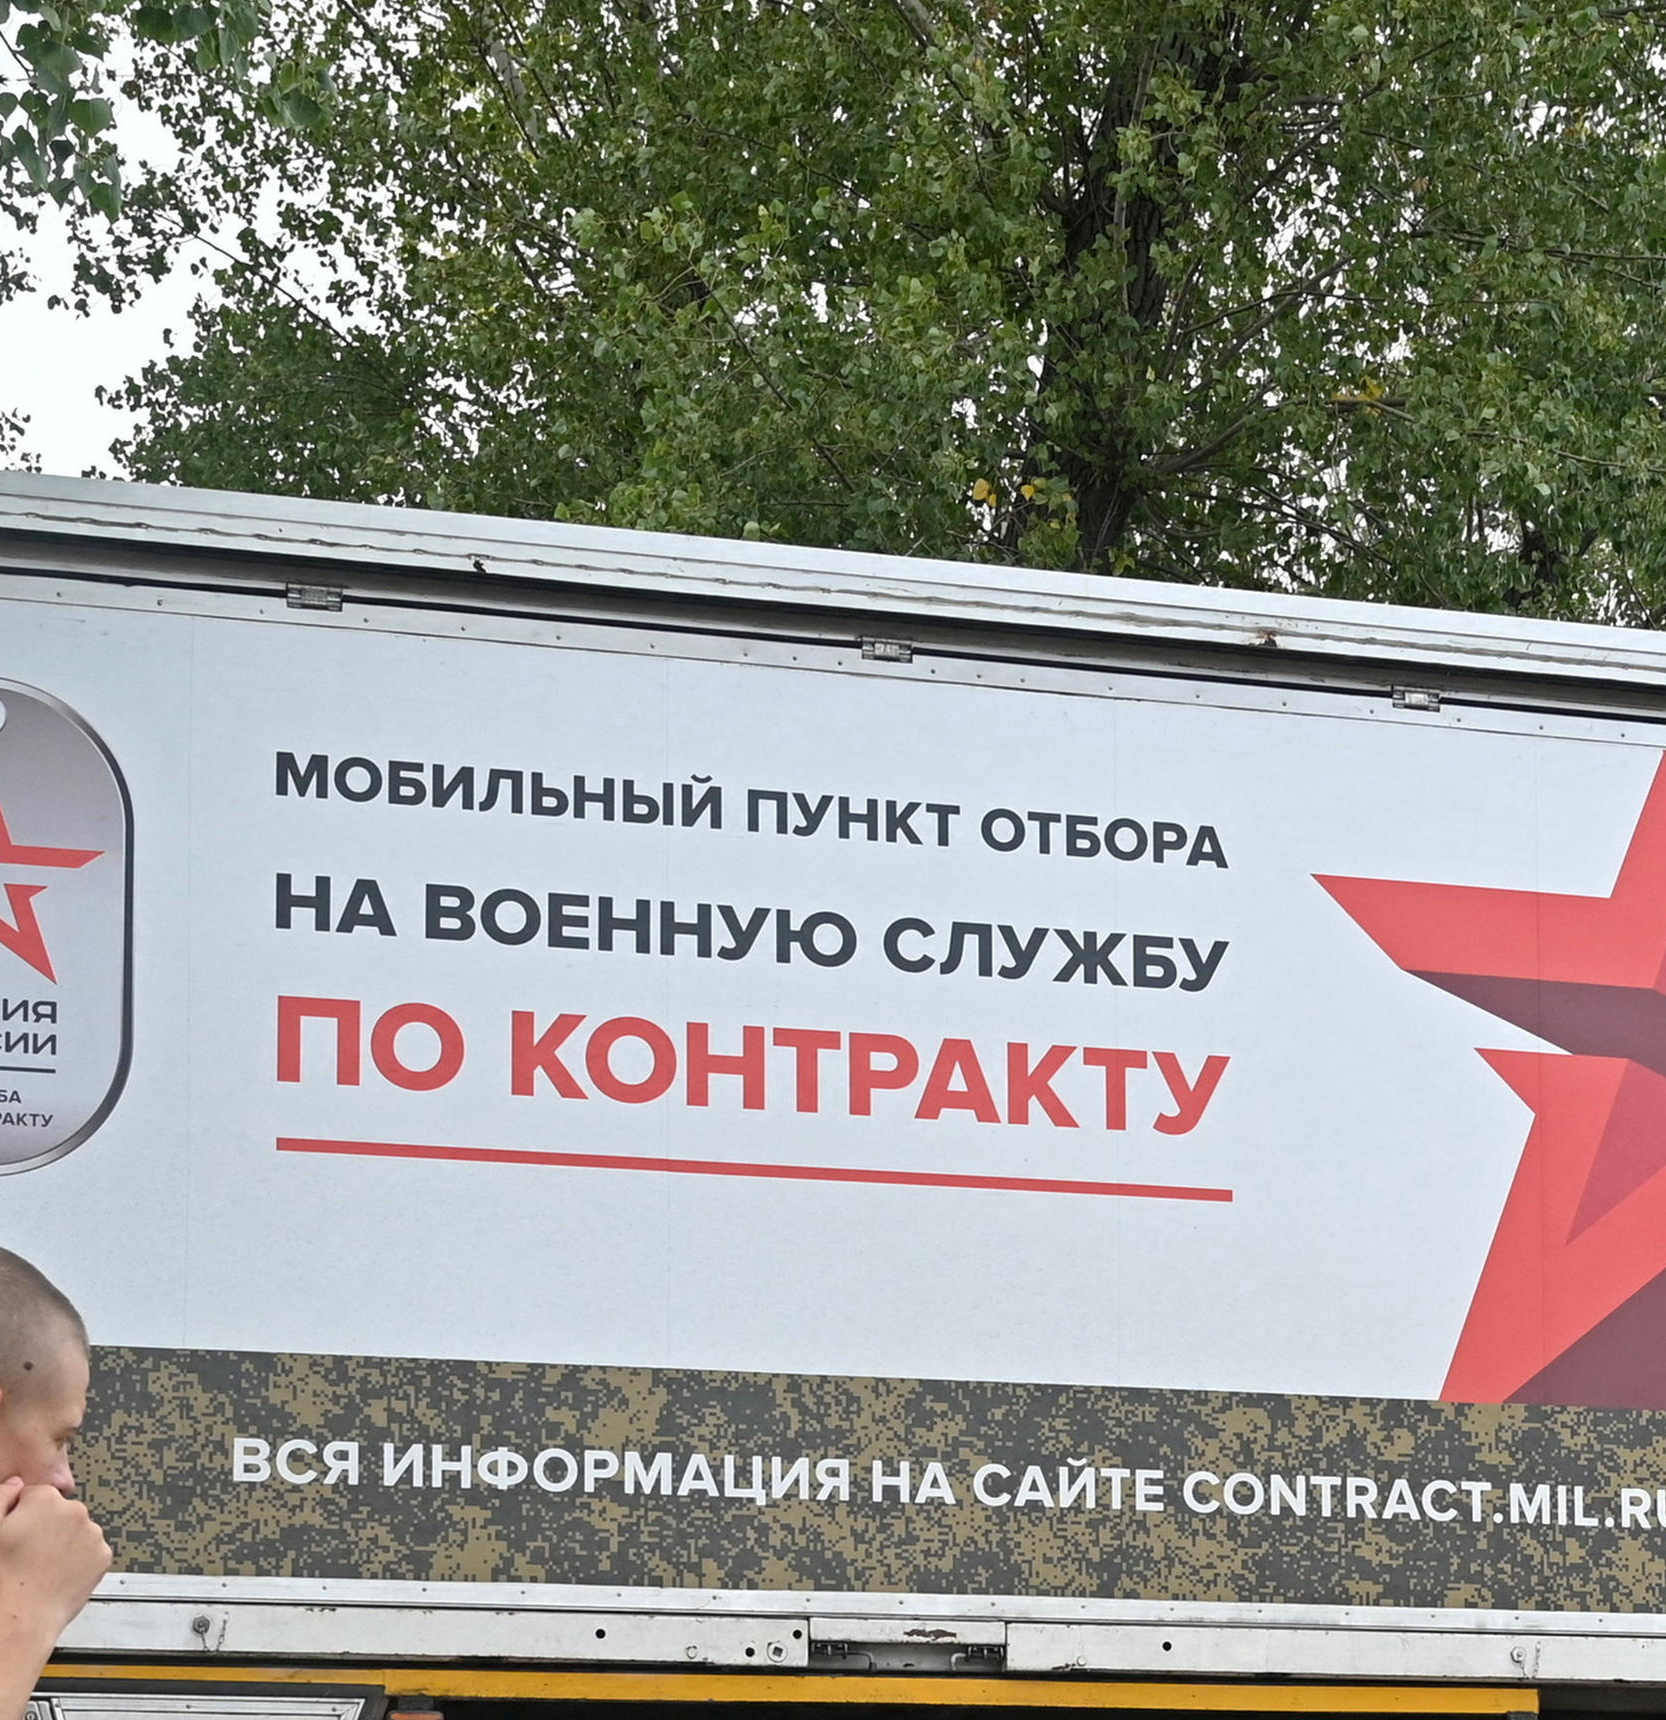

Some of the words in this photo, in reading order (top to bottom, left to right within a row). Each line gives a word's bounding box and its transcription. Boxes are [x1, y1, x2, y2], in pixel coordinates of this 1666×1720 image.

[275, 751, 722, 830] МОБИЛЬНЫЙ
[747, 788, 961, 847] ПУНКТ
[980, 808, 1229, 869] ОТБОРА
[275, 872, 397, 937] НА
[425, 883, 857, 968] ВОЕННУЮ
[883, 917, 1230, 993] СЛУЖБУ
[277, 995, 465, 1092] ПО
[511, 1010, 1231, 1136] КОНТРАКТУ
[232, 1437, 359, 1487] ВСЯ
[383, 1442, 851, 1506] ИНФОРМАЦИЯ
[872, 1459, 958, 1505] НА
[972, 1457, 1165, 1512] САЙТЕ
